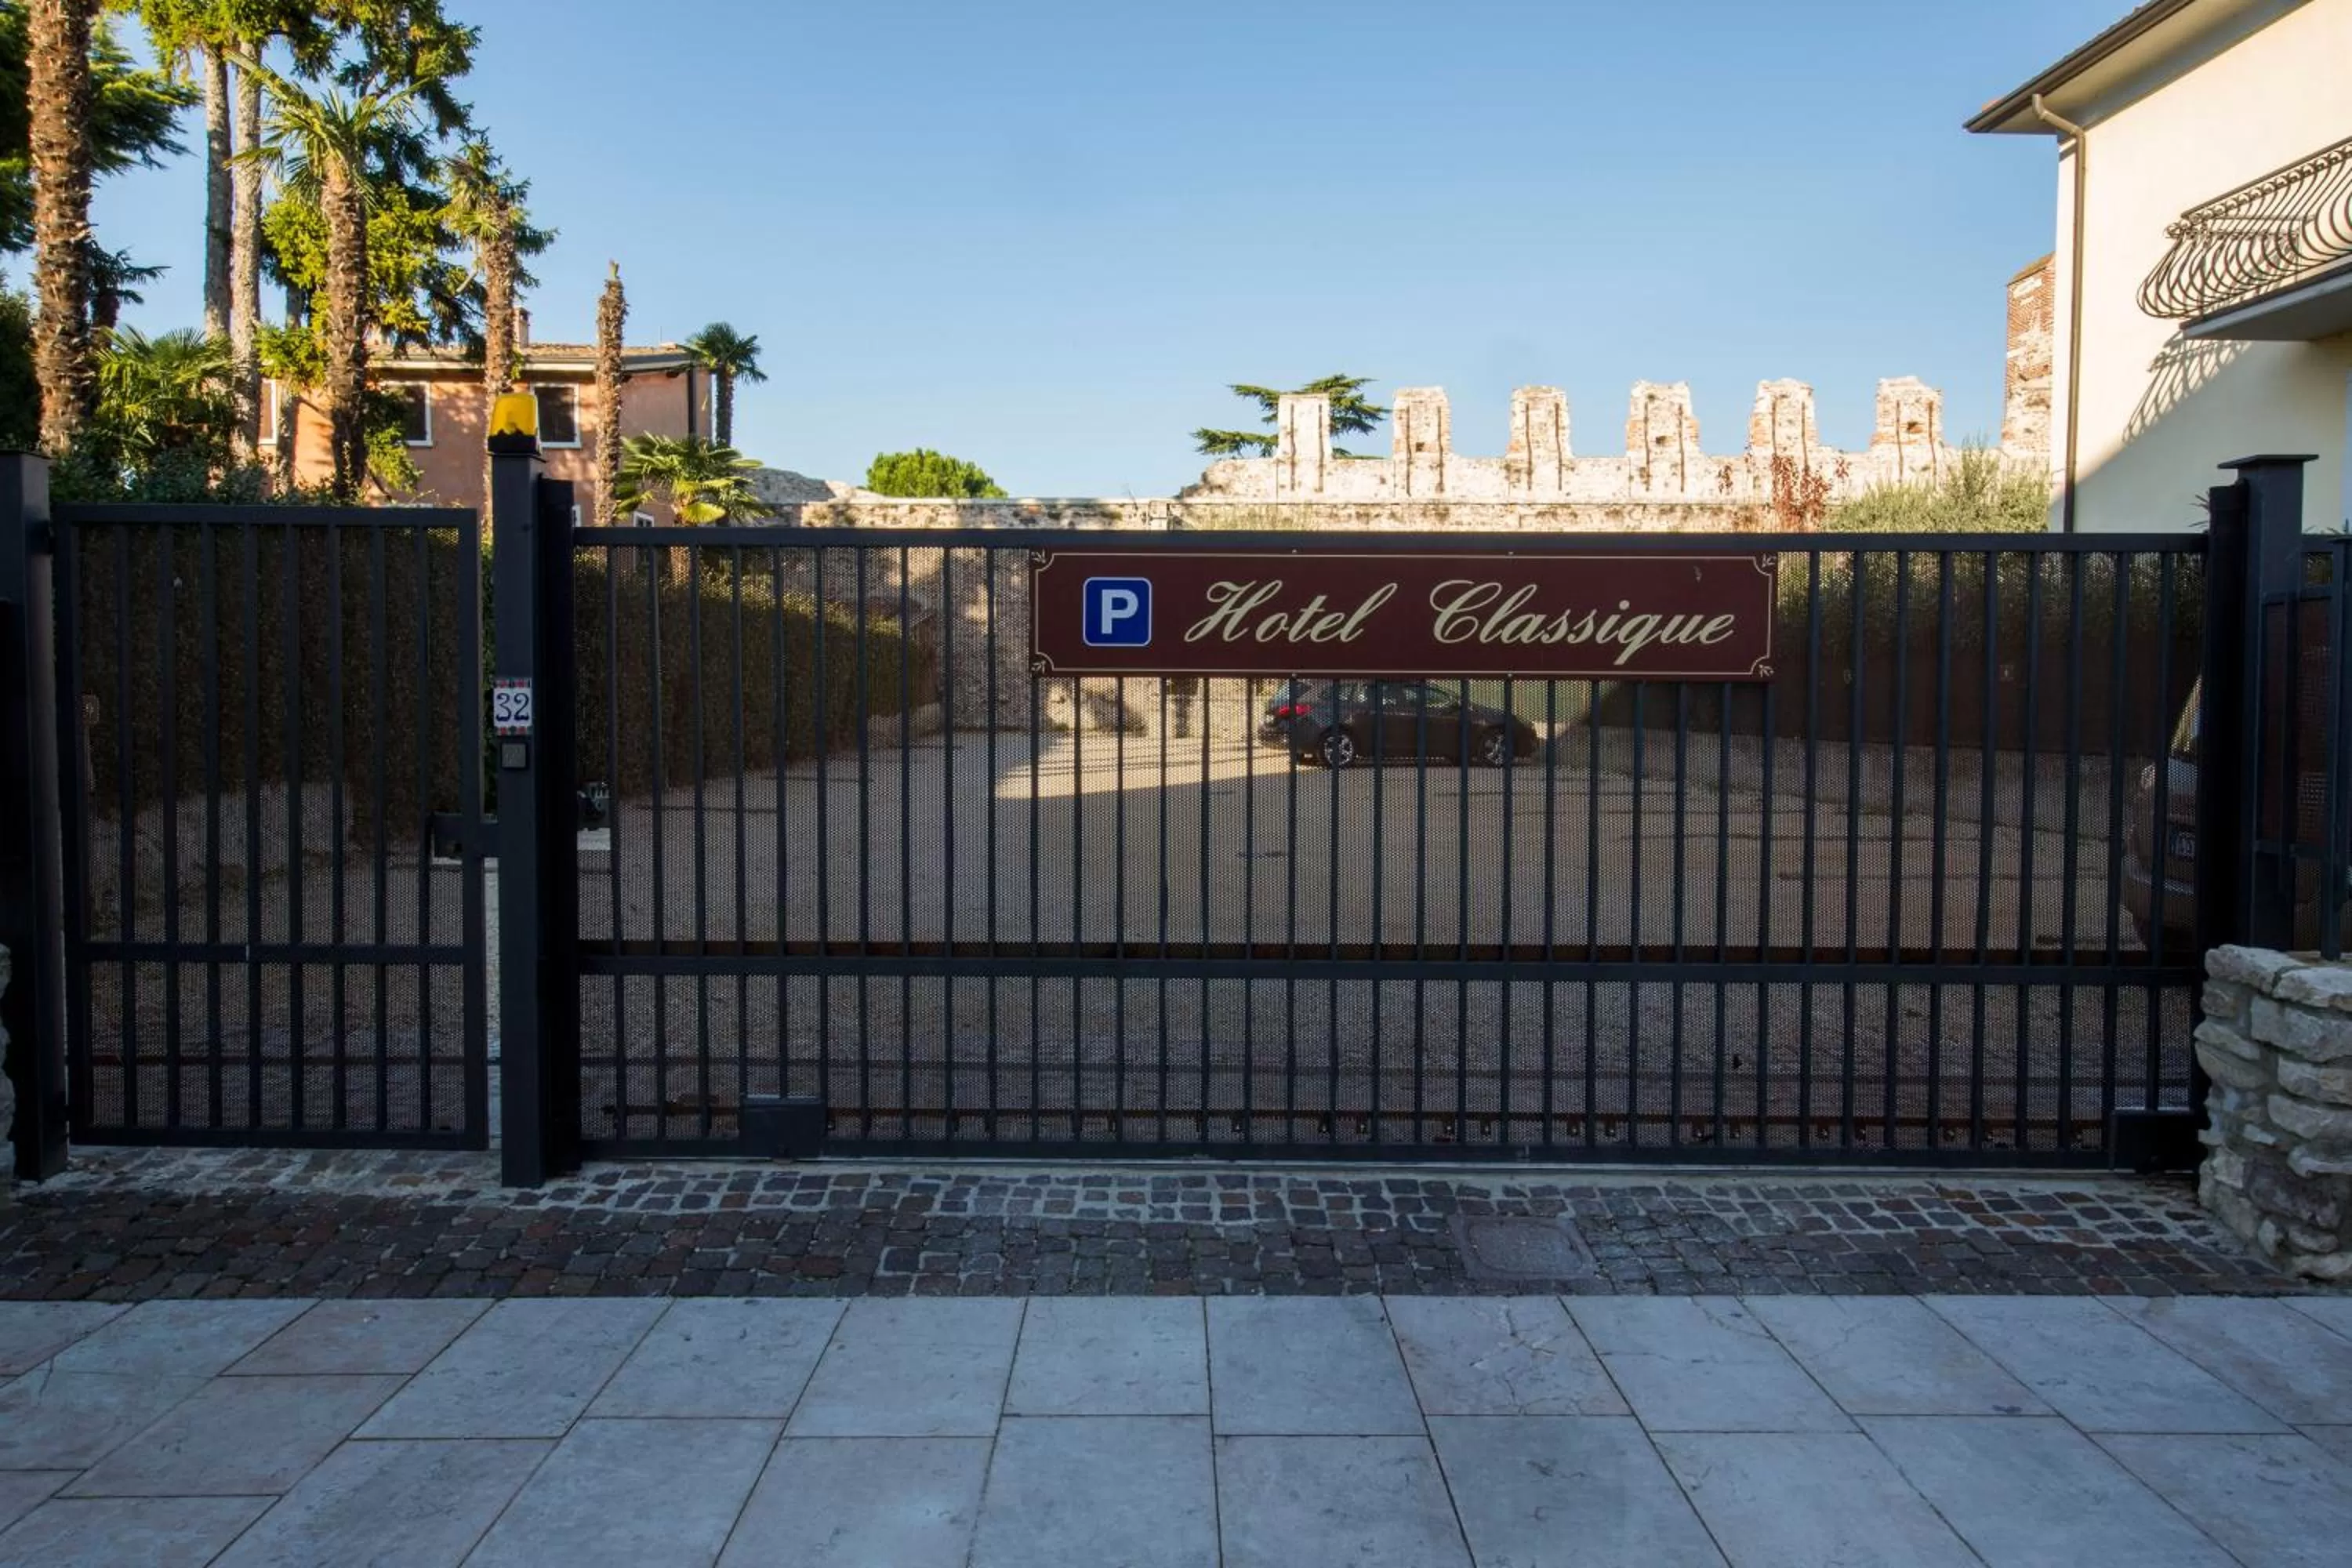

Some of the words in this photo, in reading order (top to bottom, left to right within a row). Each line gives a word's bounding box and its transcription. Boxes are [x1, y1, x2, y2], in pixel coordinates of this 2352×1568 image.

[1101, 589, 1139, 634] P
[1183, 579, 1398, 643] Hotel
[1429, 579, 1735, 666] Classique
[495, 692, 529, 721] 32
